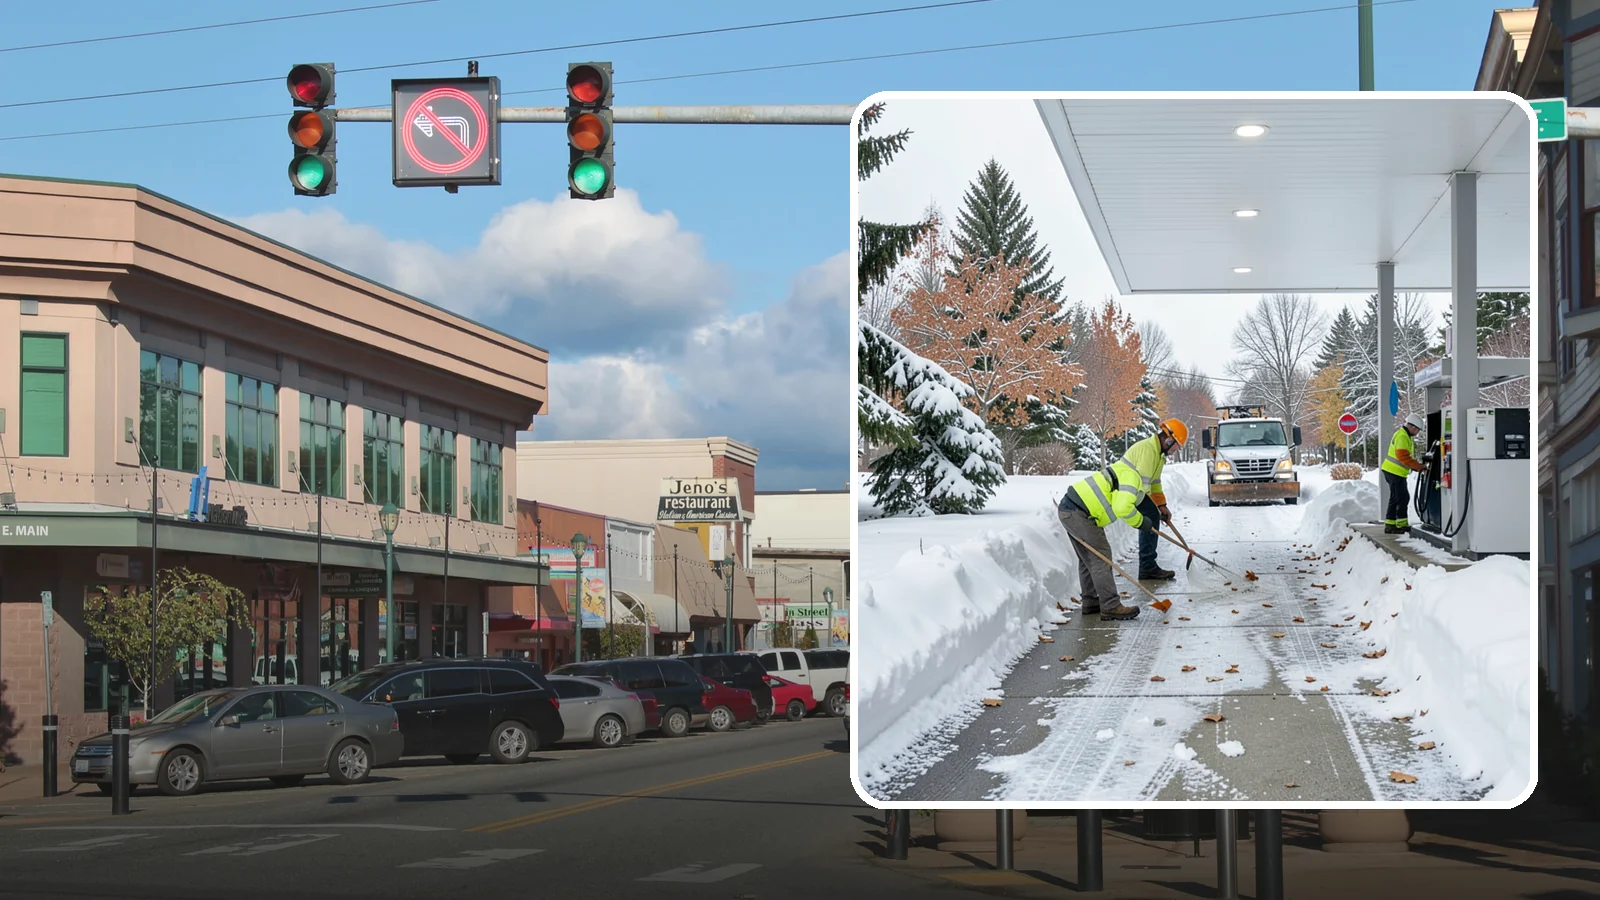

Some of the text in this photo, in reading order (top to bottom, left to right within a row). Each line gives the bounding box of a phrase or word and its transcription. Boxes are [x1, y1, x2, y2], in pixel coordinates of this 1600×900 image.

[670, 480, 727, 495] Jeno's
[665, 496, 731, 509] restaurant
[658, 510, 681, 519] Italian
[686, 509, 714, 519] American
[715, 509, 737, 519] Cuisine
[2, 525, 49, 536] E. MAIN
[797, 608, 828, 617] Street
